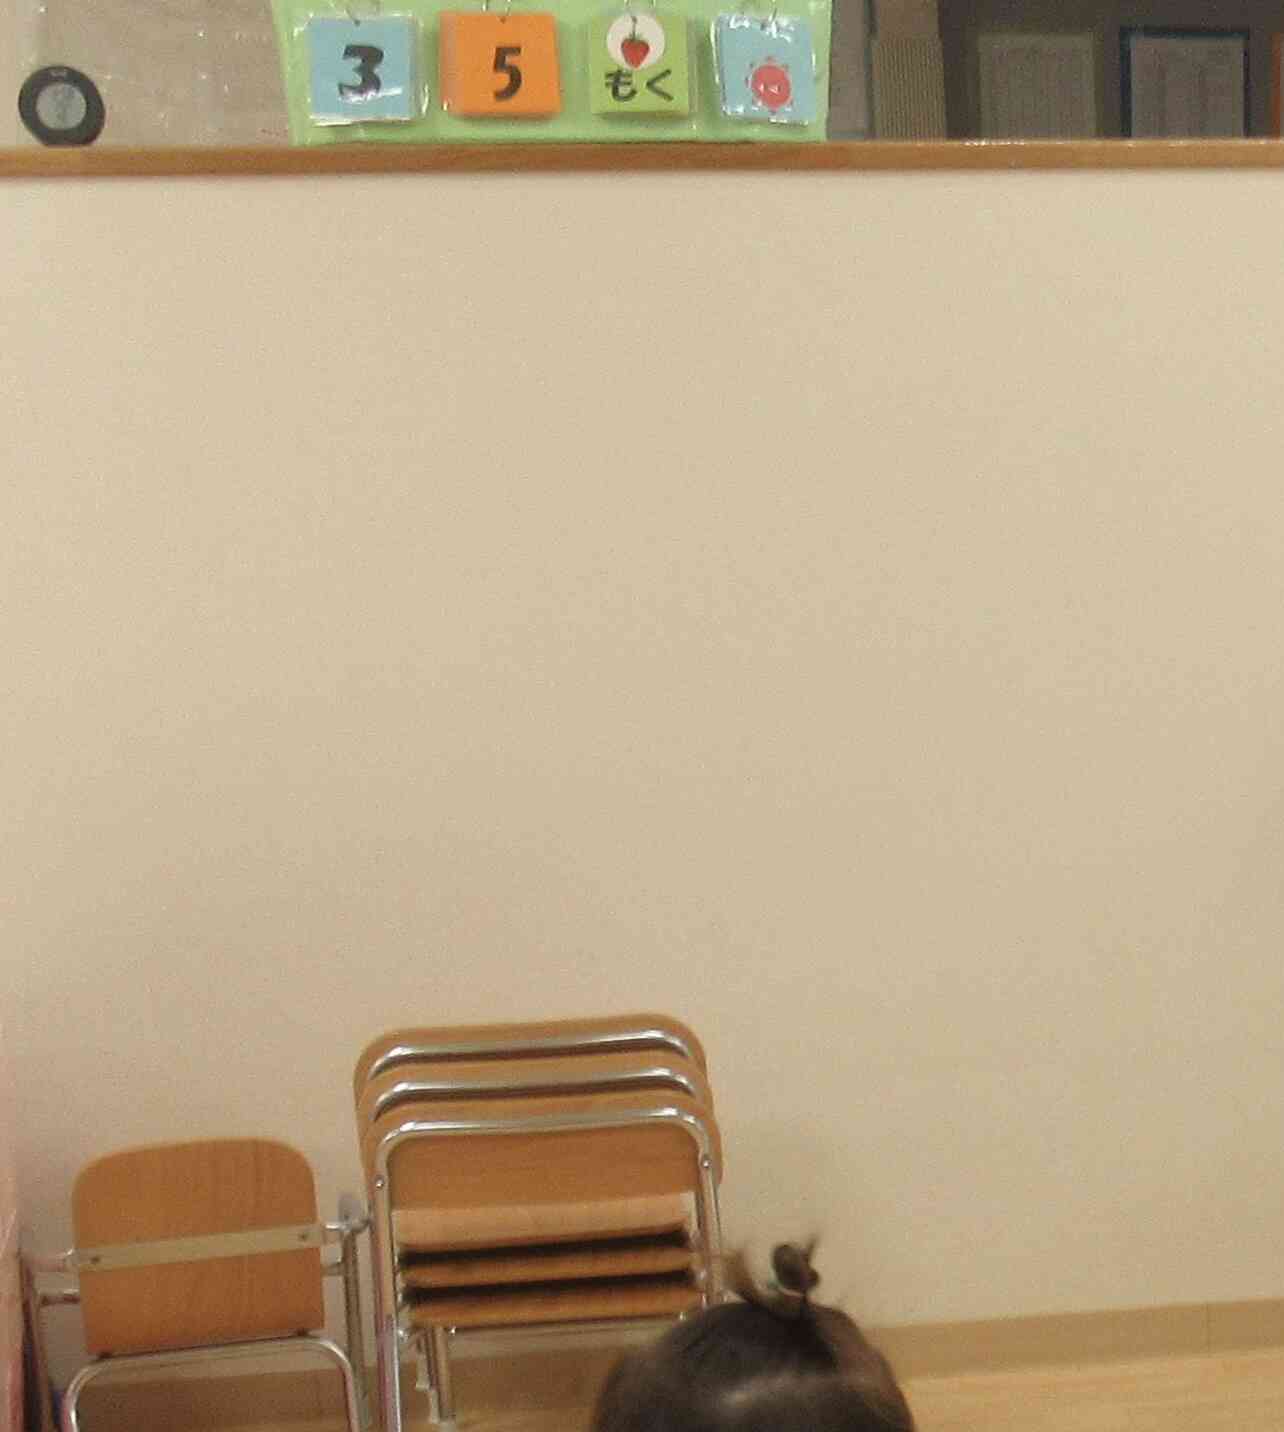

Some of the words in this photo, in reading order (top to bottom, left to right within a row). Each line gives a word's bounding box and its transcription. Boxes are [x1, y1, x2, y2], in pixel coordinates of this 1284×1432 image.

[337, 44, 384, 95] 3
[492, 46, 523, 101] 5
[604, 68, 674, 102] もく
